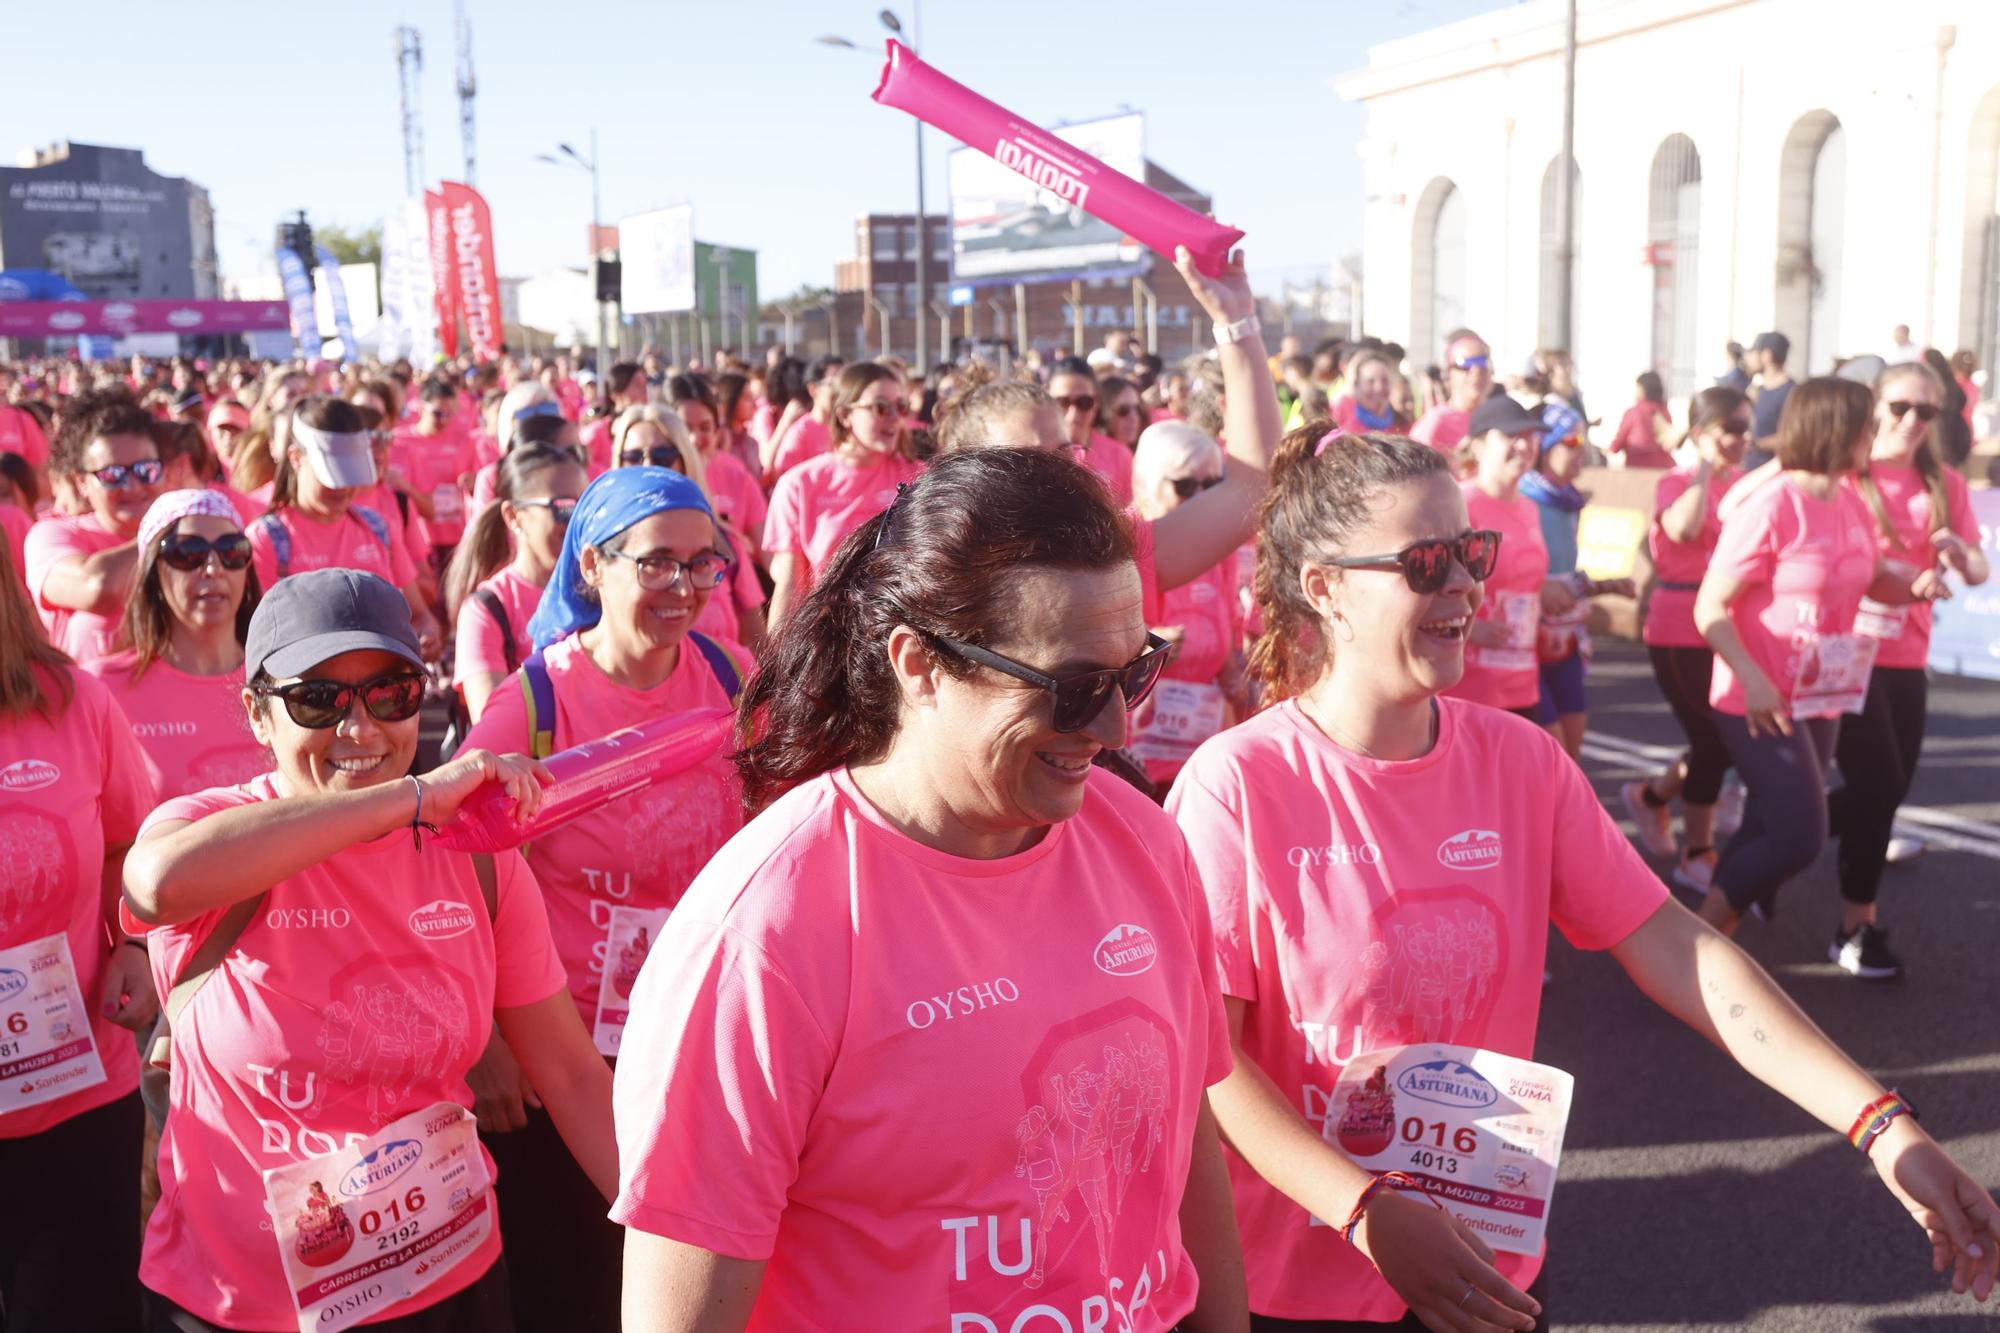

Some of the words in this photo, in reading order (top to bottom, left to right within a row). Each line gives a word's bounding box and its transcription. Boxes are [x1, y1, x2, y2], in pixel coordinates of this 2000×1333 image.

[132, 720, 197, 737] OYSHO
[1287, 843, 1381, 867] OYSHO
[581, 867, 631, 898] TU
[266, 908, 350, 930] OYSHO
[414, 914, 473, 932] ASTURIANA
[31, 957, 60, 972] SUMA
[1102, 943, 1154, 969] ASTURIANA
[906, 977, 1020, 1029] OYSHO
[1301, 1022, 1363, 1067] TU
[2, 1067, 17, 1077] LA
[18, 1055, 56, 1072] MUJER
[35, 1064, 89, 1090] Santander
[247, 1062, 315, 1110] TU
[1404, 1073, 1489, 1103] ASTURIANA
[1508, 1085, 1553, 1103] SUMA
[1401, 1116, 1479, 1154] 016
[348, 1148, 419, 1193] ASTURIANA
[1410, 1149, 1457, 1174] 4013
[1425, 1180, 1441, 1192] LA
[1444, 1185, 1491, 1204] MUJER
[1494, 1196, 1526, 1210] 2023
[359, 1186, 426, 1236] 016
[1456, 1213, 1526, 1238] Santander
[377, 1220, 421, 1250] 2192
[430, 1226, 480, 1266] Santander
[941, 1215, 1033, 1281] TU
[319, 1263, 377, 1294] CARRERA
[379, 1255, 398, 1269] DE
[400, 1248, 413, 1262] LA
[415, 1225, 452, 1254] MUJER
[320, 1283, 383, 1323] OYSHO
